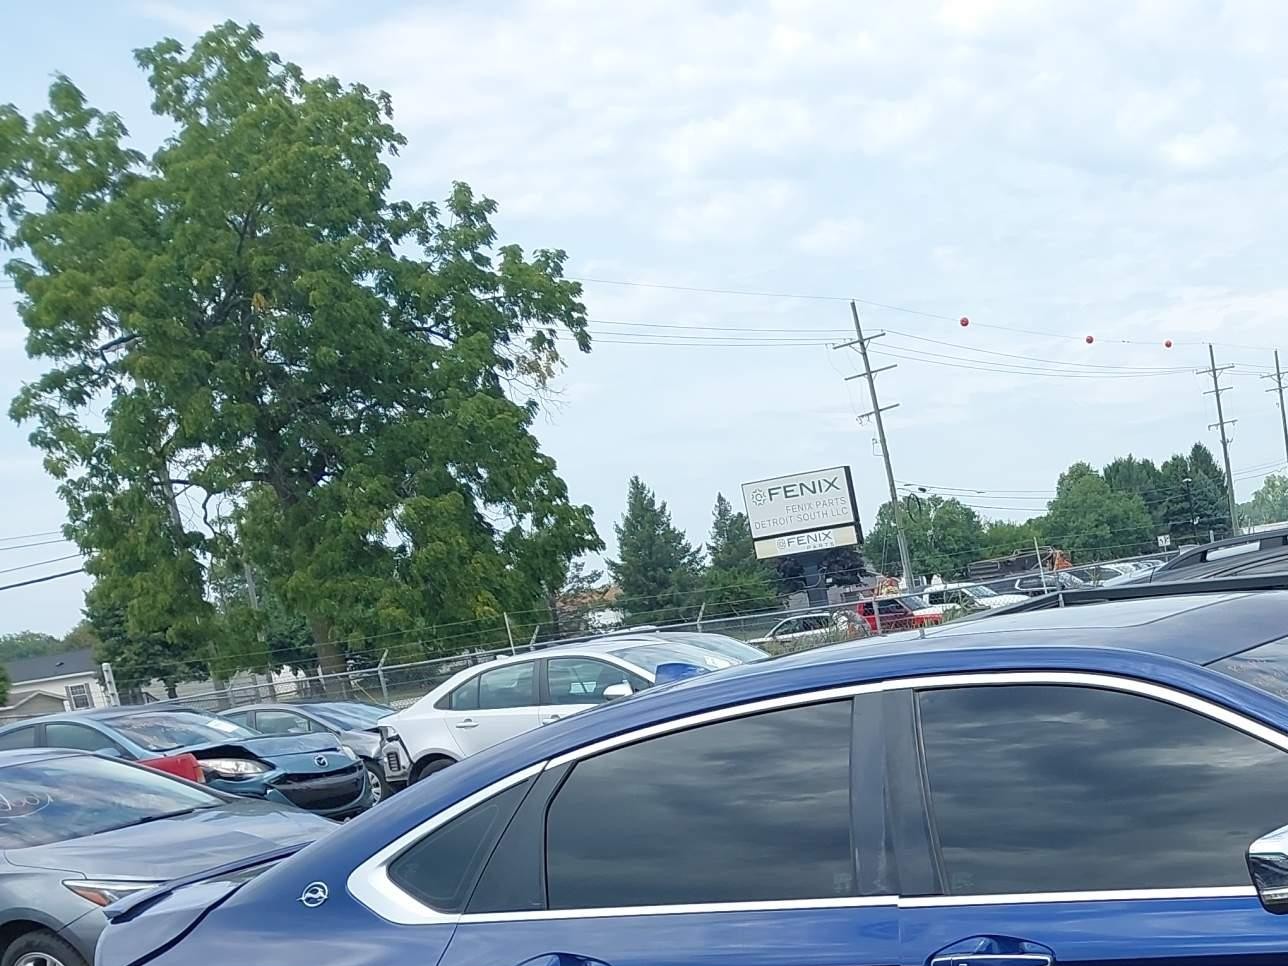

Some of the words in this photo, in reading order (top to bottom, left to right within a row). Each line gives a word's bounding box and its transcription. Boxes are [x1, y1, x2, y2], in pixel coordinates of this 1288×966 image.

[768, 477, 840, 501] FENIX
[786, 502, 813, 514] FENIX
[816, 497, 847, 507] PARTS
[755, 516, 794, 530] DETROIT
[797, 511, 828, 521] SOUTH
[831, 507, 849, 517] LLC
[787, 531, 833, 547] FENIX
